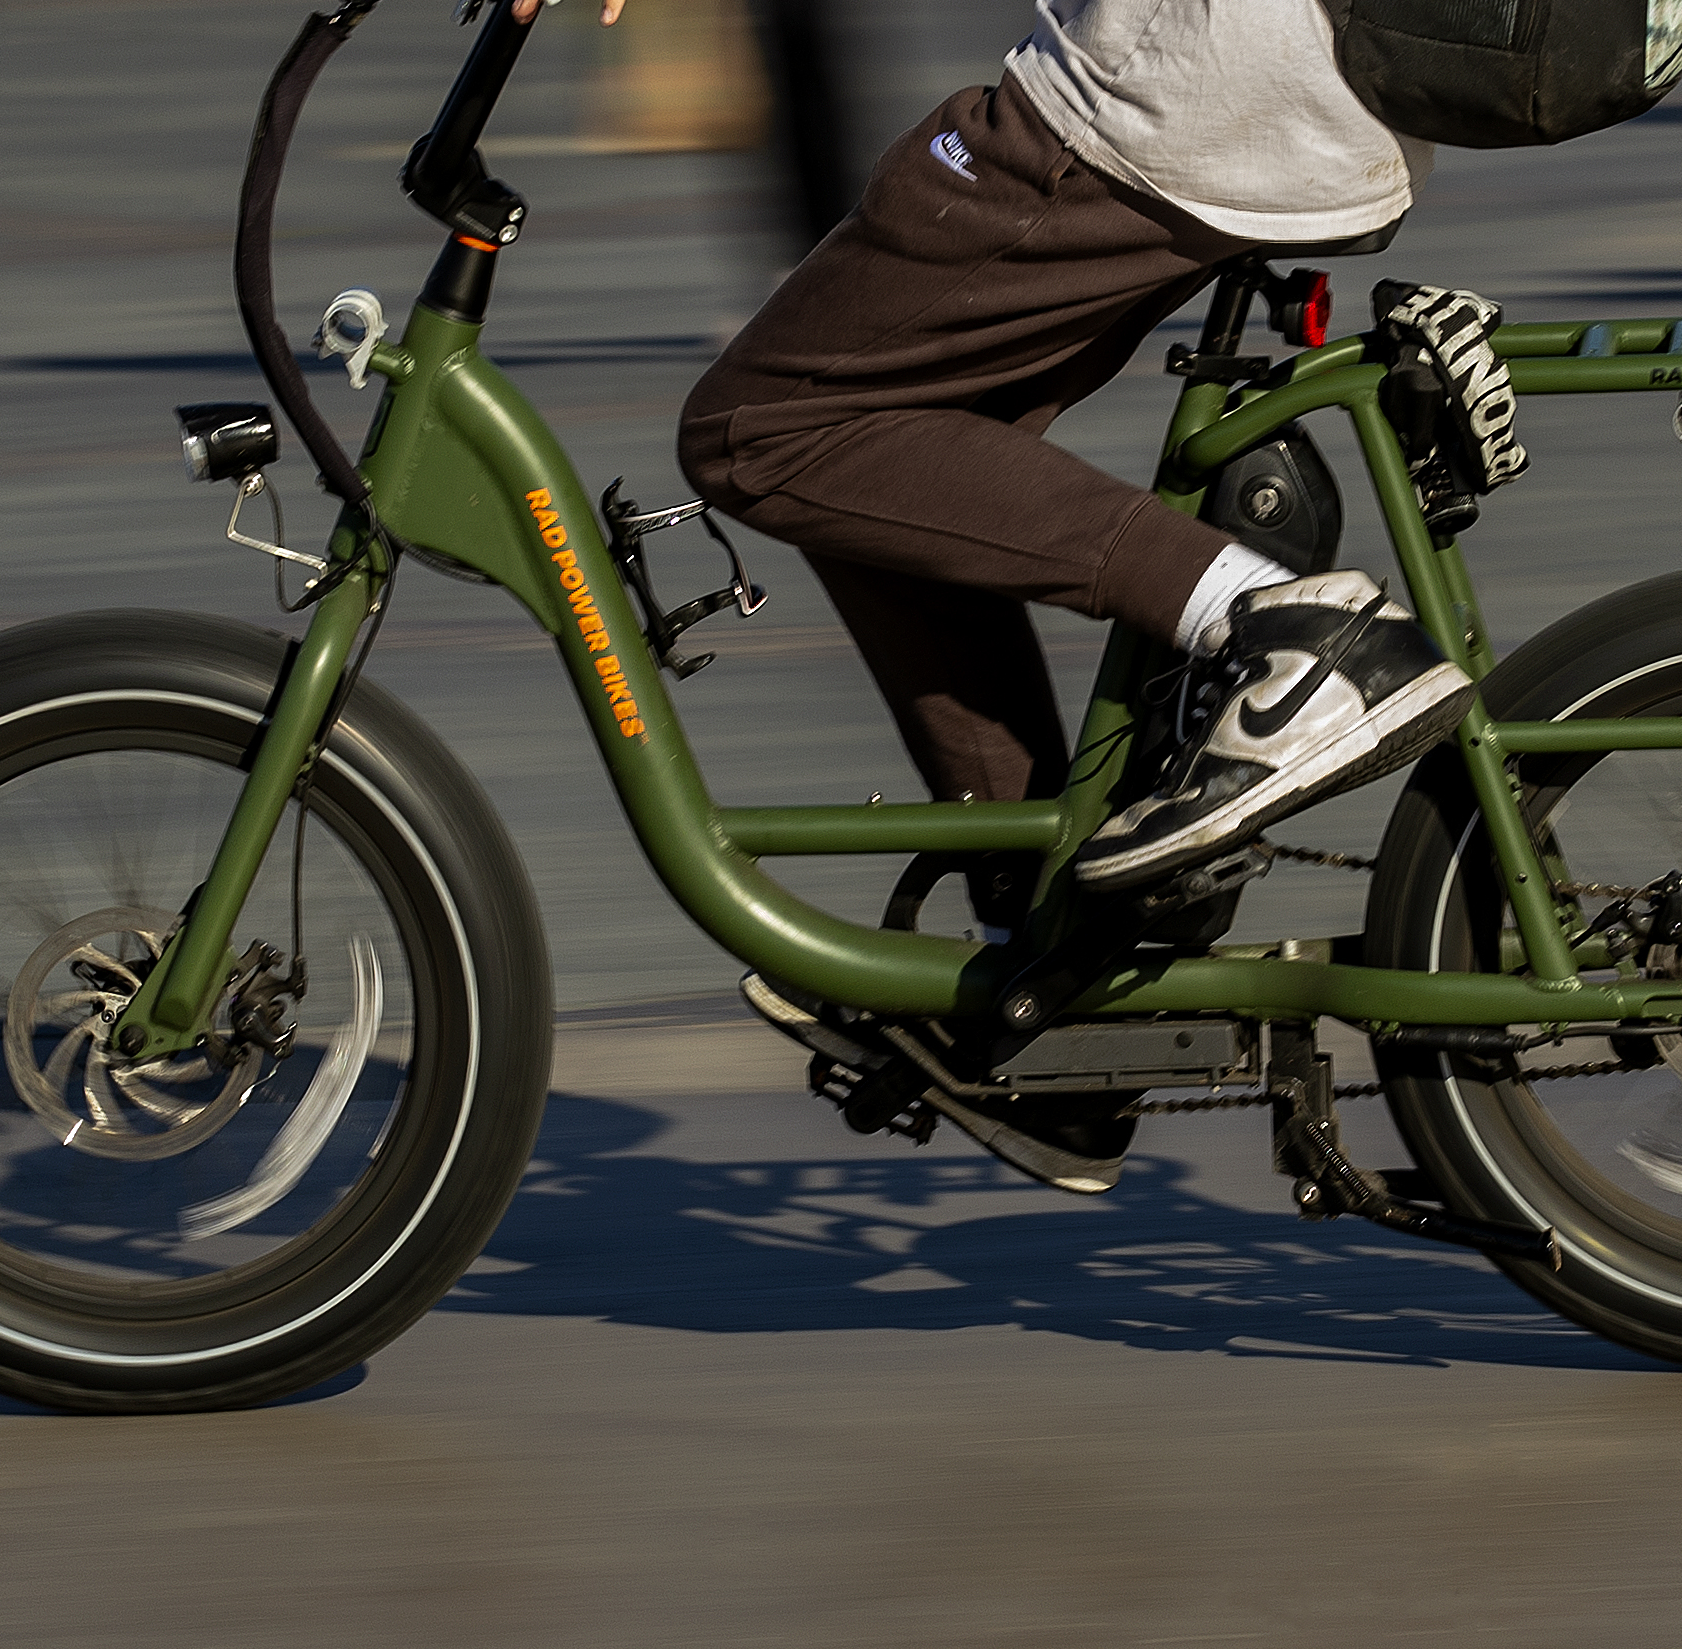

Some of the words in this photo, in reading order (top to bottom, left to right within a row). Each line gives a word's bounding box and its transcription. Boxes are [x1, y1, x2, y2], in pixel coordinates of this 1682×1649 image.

[525, 487, 568, 549] RAD
[551, 549, 611, 653] POWER
[594, 654, 646, 738] BIKES
